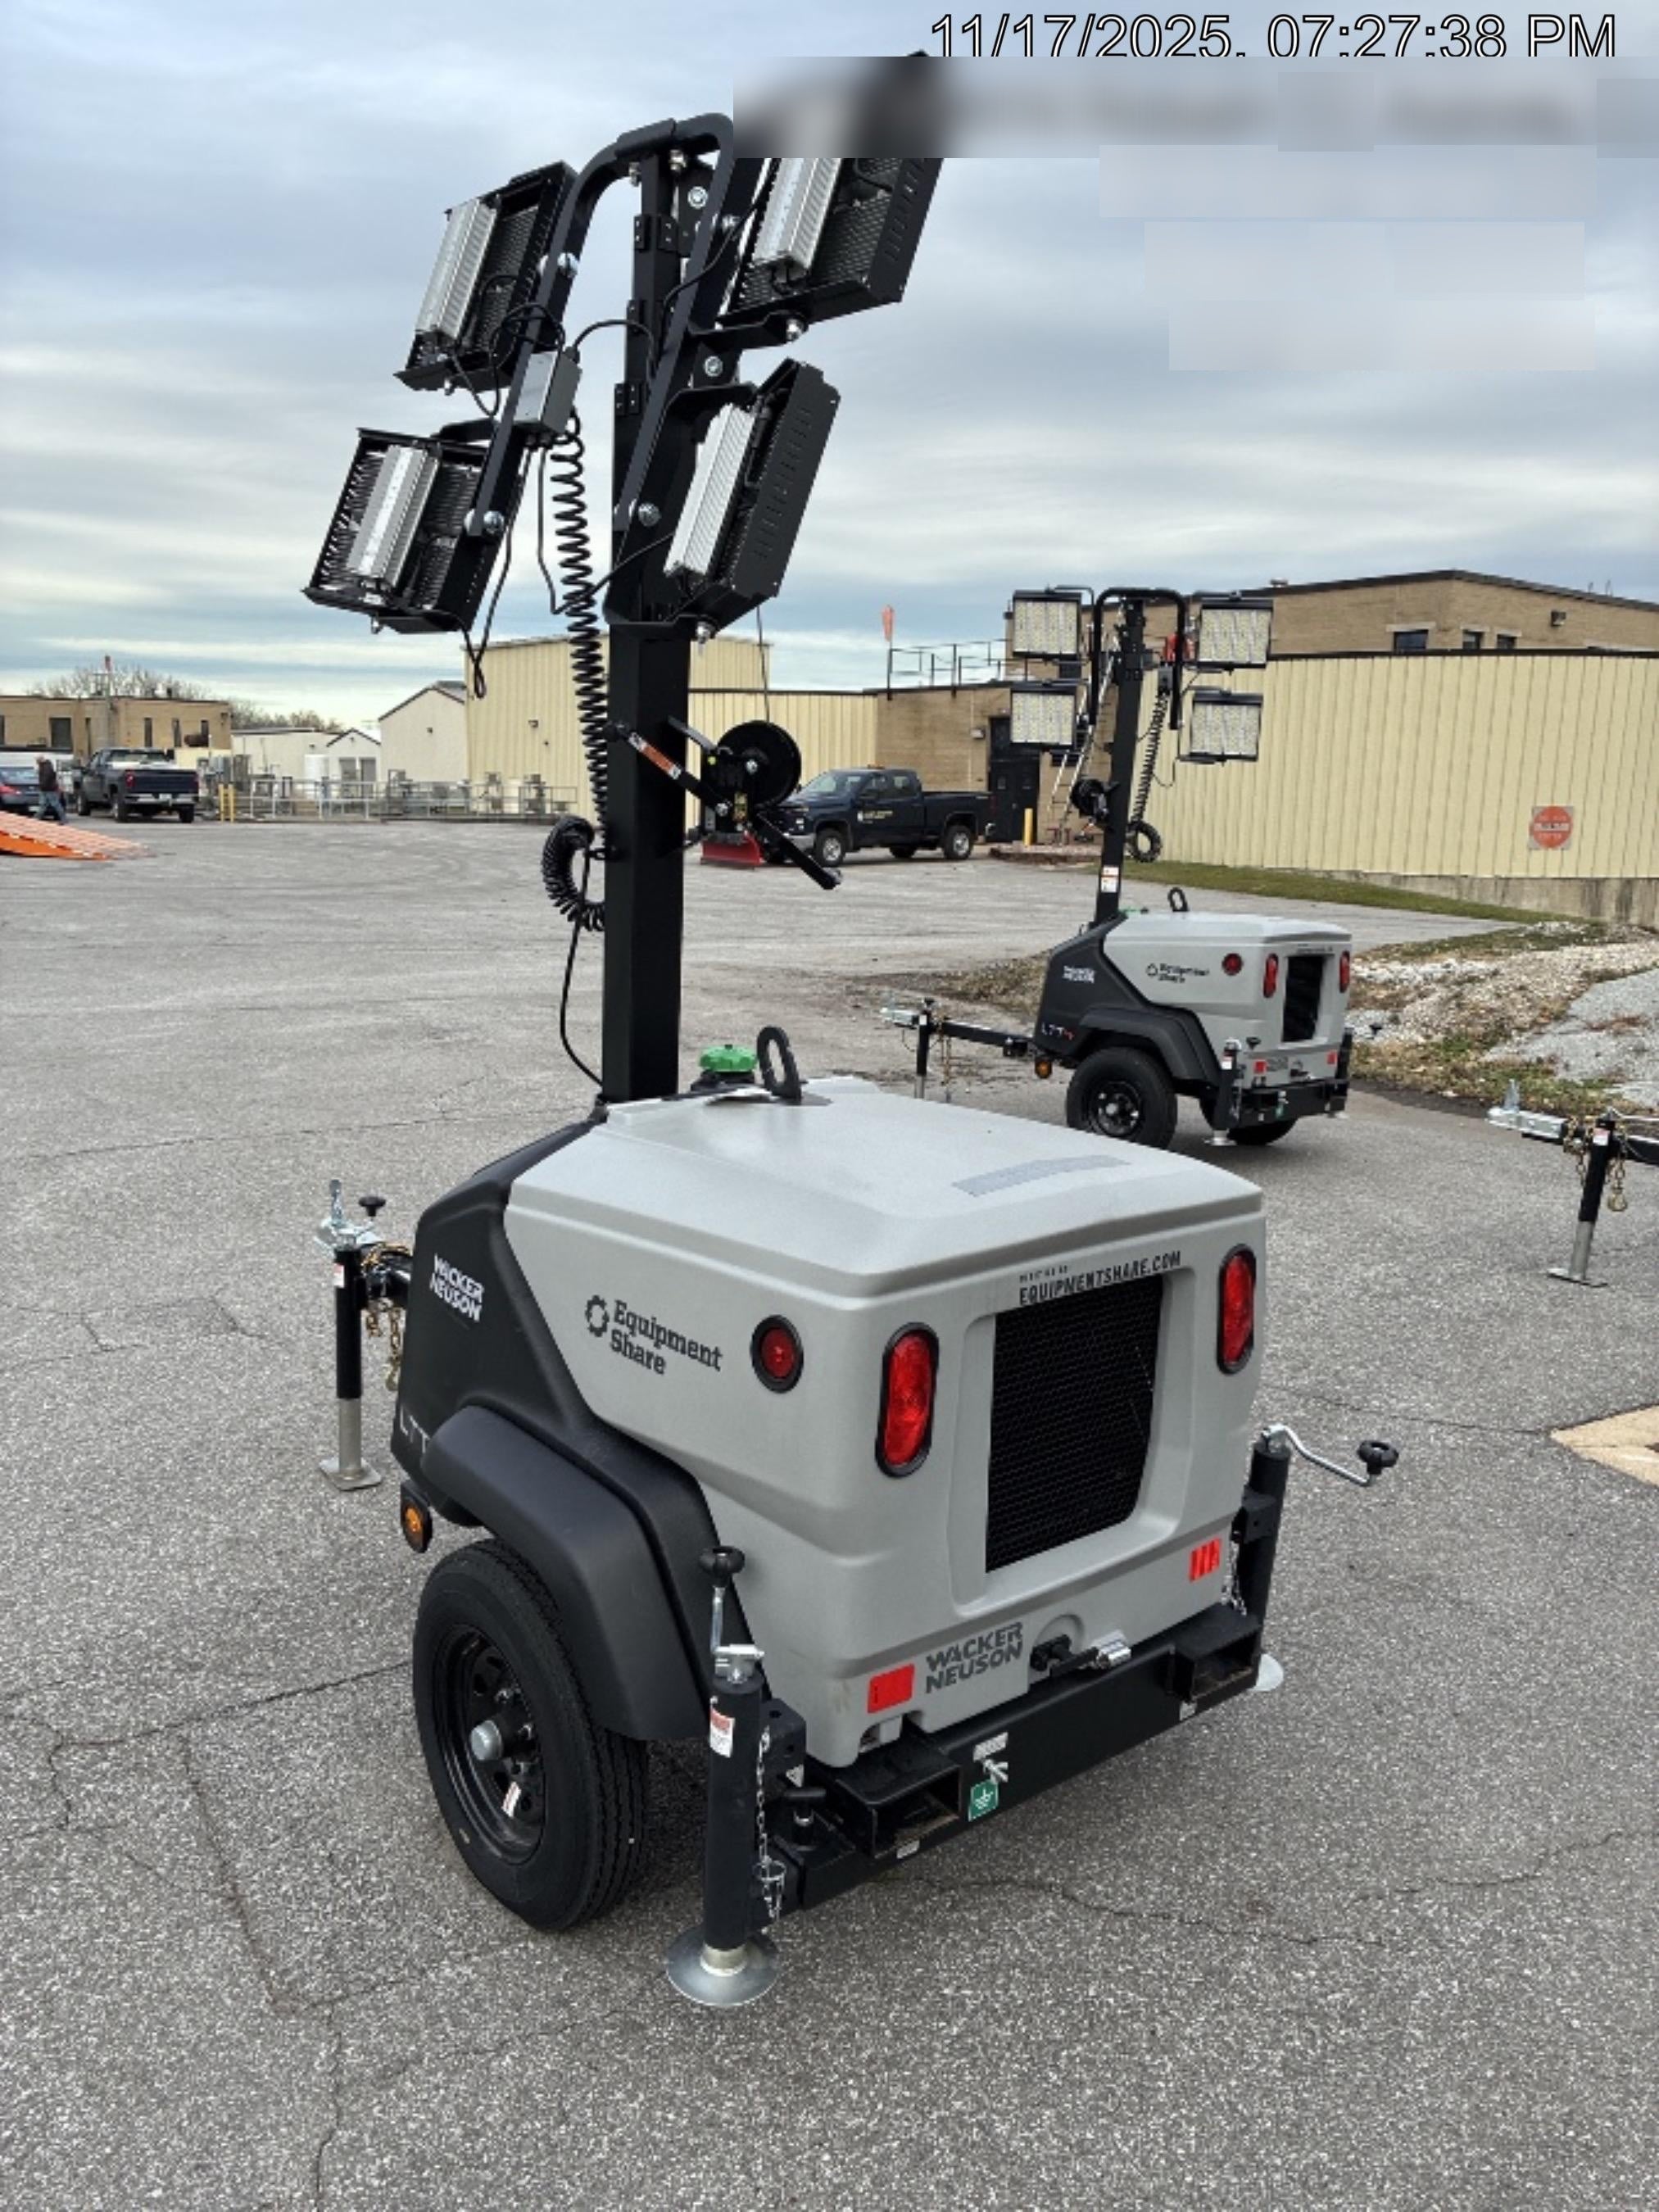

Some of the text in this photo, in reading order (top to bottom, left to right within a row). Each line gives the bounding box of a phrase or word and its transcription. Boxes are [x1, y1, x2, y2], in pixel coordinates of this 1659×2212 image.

[429, 1272, 482, 1321] NEUSON
[433, 1253, 484, 1303] WACKER
[1019, 1250, 1181, 1305] EQUIPMENTSHARE.COM
[610, 1328, 665, 1375] Share
[614, 1299, 723, 1371] Equipment
[925, 1621, 1023, 1672] WACKER
[925, 1641, 1023, 1693] NEUSON
